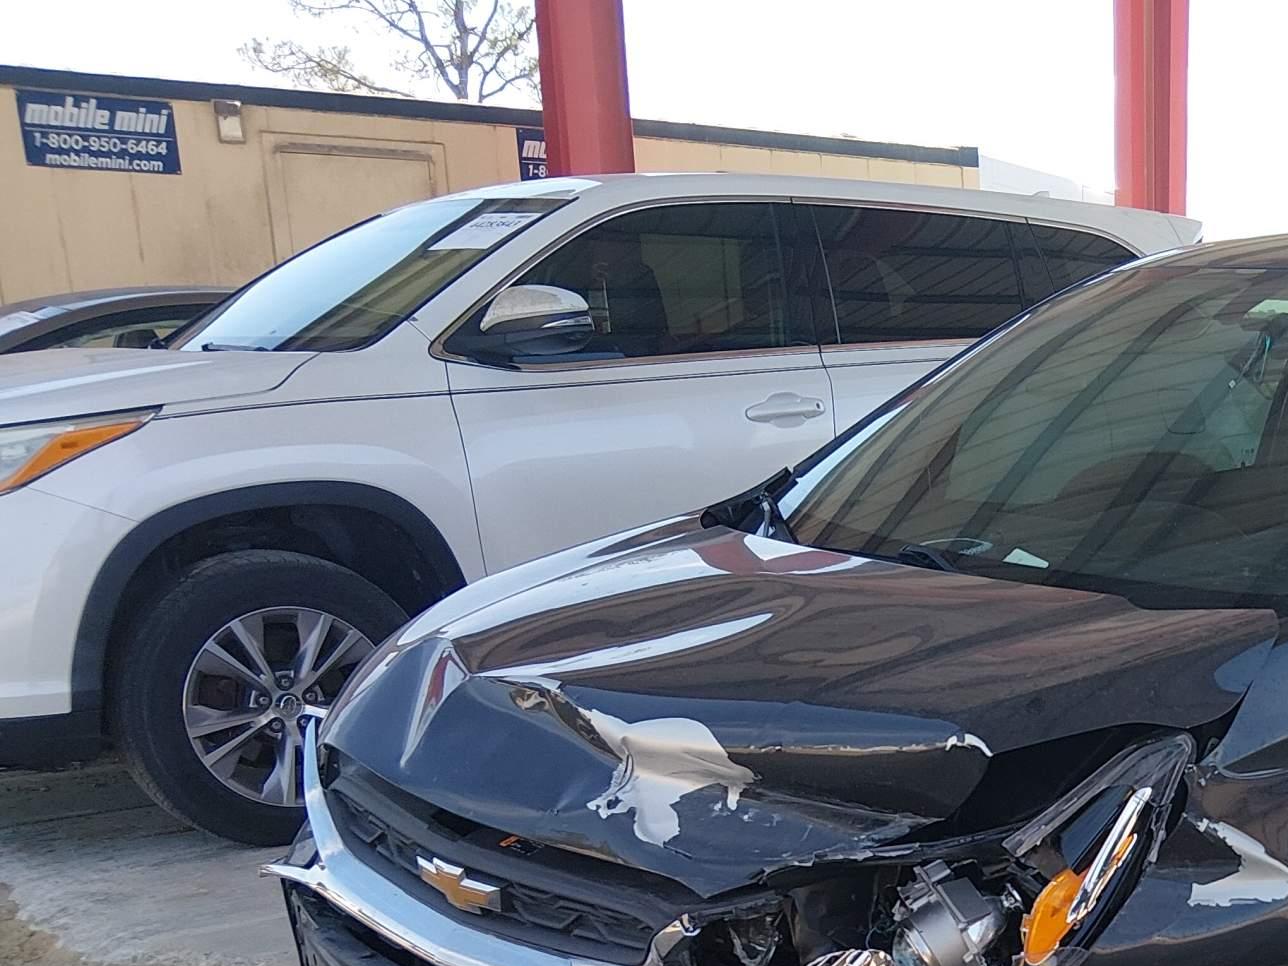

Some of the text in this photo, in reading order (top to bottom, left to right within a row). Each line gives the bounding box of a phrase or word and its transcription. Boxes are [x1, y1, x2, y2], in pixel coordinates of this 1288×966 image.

[24, 96, 169, 134] mobile mini
[33, 132, 168, 155] 1-800-950-6464
[45, 152, 164, 171] mobilemini.com
